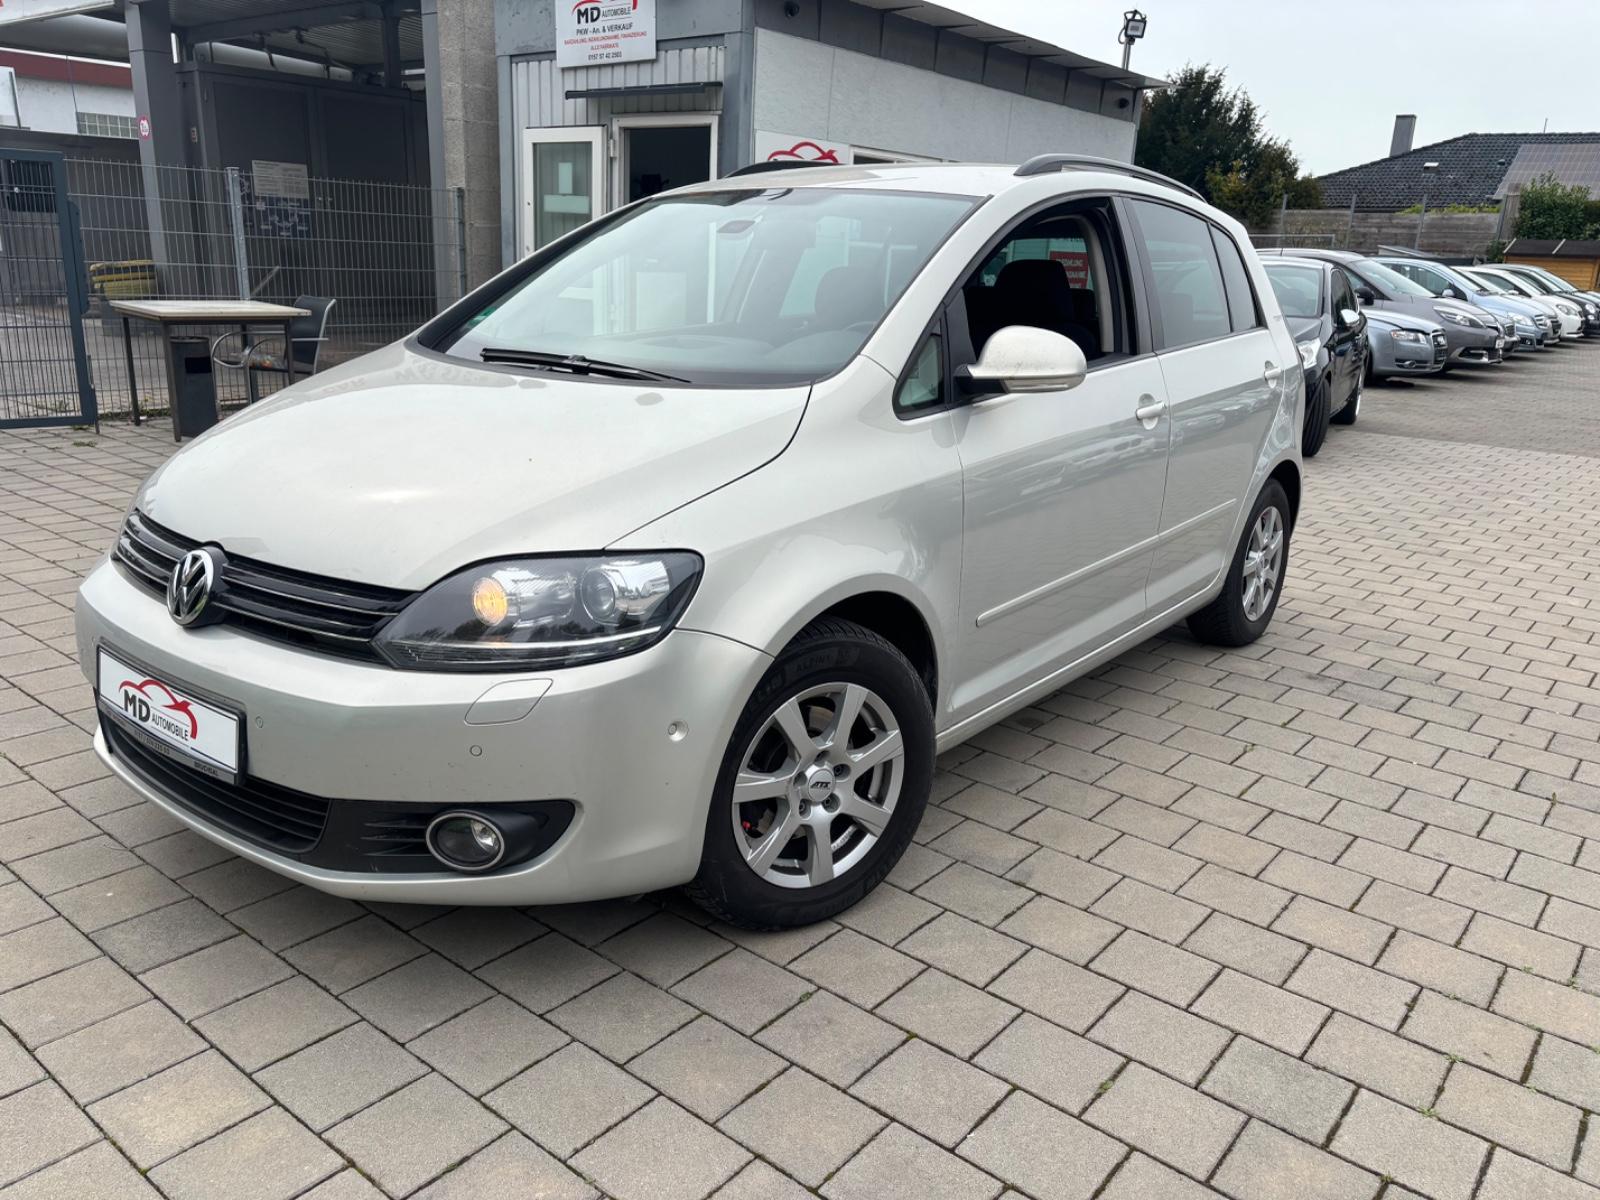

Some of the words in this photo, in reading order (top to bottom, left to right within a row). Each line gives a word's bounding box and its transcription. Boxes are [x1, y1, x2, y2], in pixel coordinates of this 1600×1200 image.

[577, 7, 600, 24] MD
[602, 7, 631, 18] AUTOMOBILE
[576, 27, 588, 36] PKW
[607, 22, 633, 32] VERKAUF
[124, 689, 150, 723] MD
[152, 714, 188, 741] AUTOMOBILE
